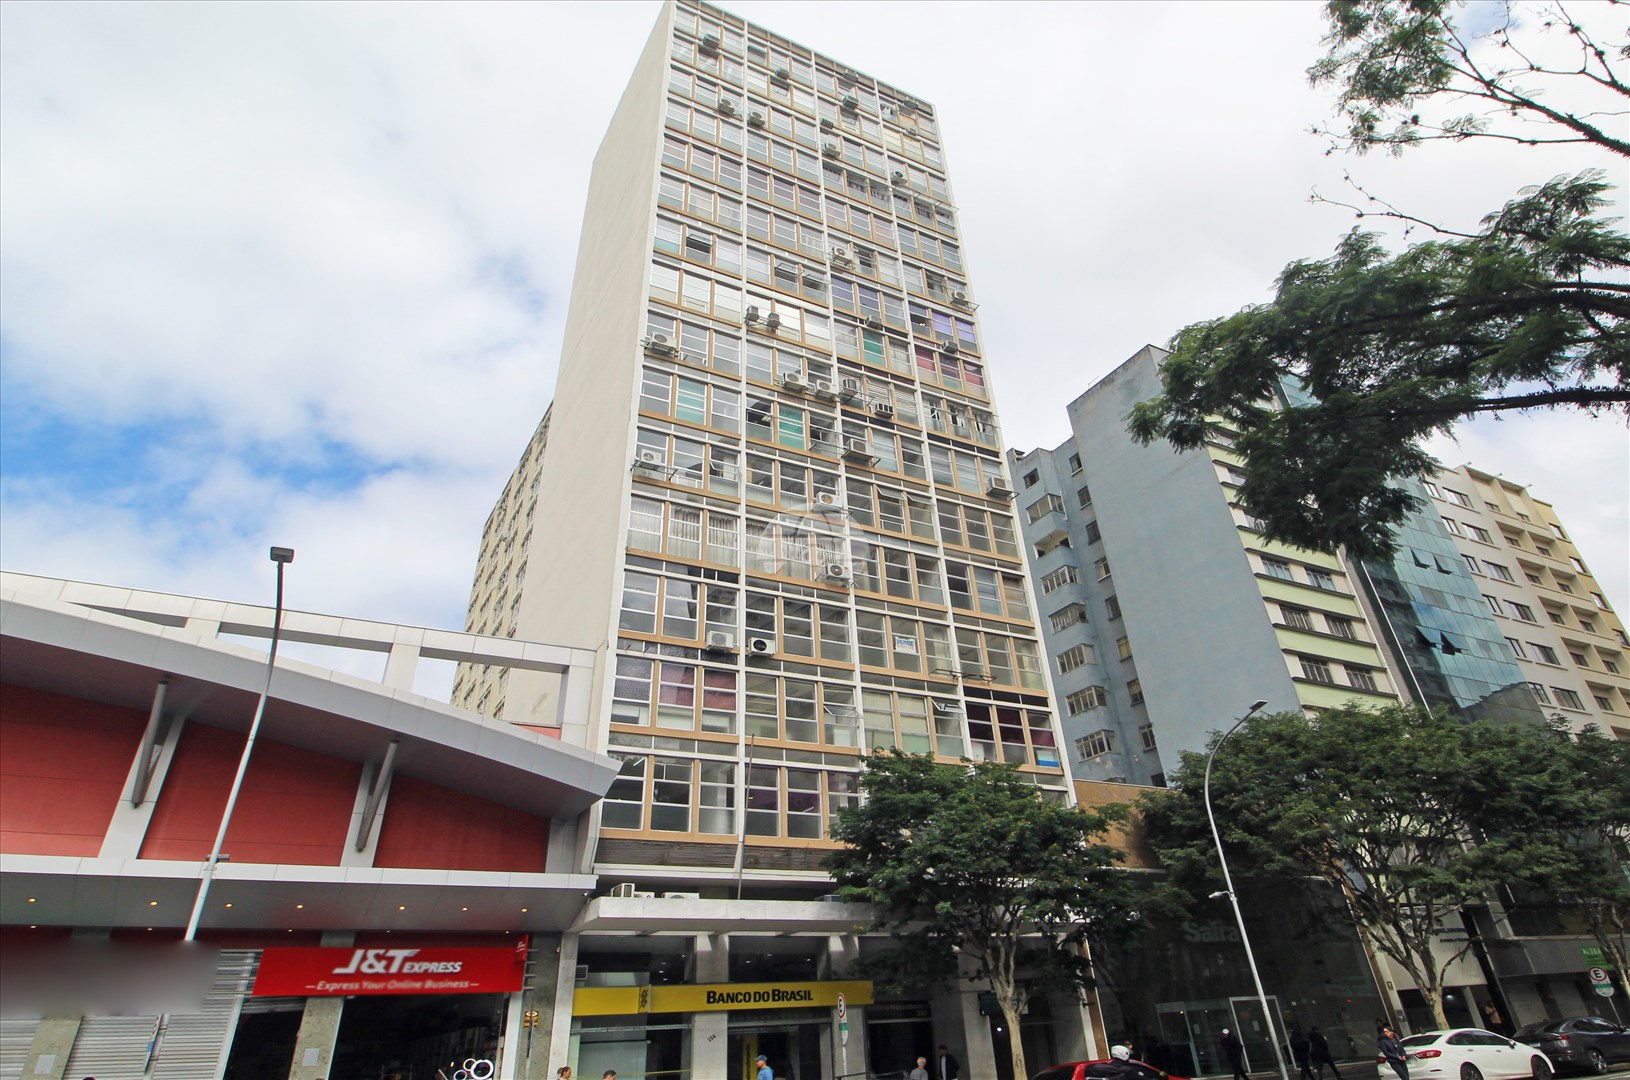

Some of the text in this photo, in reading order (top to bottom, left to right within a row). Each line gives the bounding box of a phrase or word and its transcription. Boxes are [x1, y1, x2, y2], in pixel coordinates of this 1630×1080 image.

[1182, 919, 1239, 942] Safra
[332, 949, 462, 974] J&T EXPRESS
[1593, 969, 1602, 979] E
[317, 978, 470, 993] Express Your Online Business
[707, 988, 814, 1004] BANCO DO BRASIL
